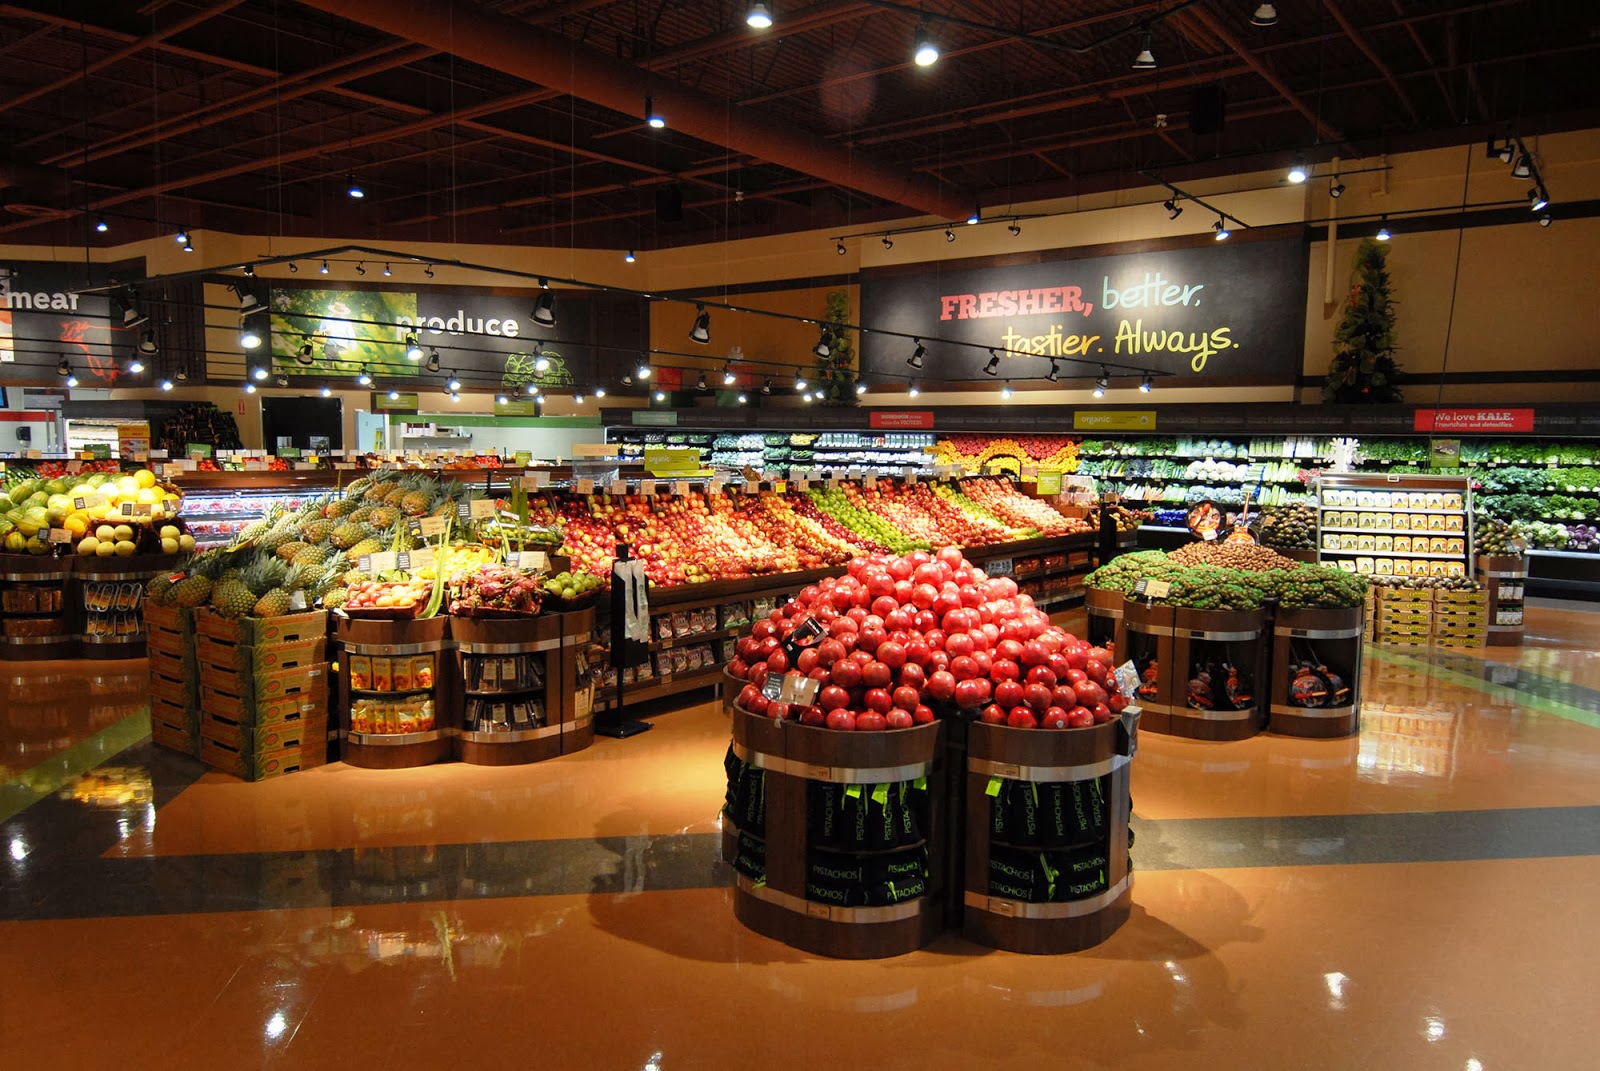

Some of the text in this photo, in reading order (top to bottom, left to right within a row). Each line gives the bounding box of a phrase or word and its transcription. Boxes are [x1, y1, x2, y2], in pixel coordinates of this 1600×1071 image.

[7, 290, 79, 310] meat
[940, 285, 1093, 320] FRESHER,
[396, 310, 519, 341] produce
[1002, 319, 1239, 372] tastier. Always.
[1082, 415, 1110, 425] organic
[1453, 411, 1476, 421] love
[1477, 412, 1515, 421] KALE.
[649, 455, 670, 464] organic
[855, 799, 865, 840] PISTACHIO
[813, 864, 858, 880] PISTACHIOS
[886, 883, 923, 901] PTACHIOS
